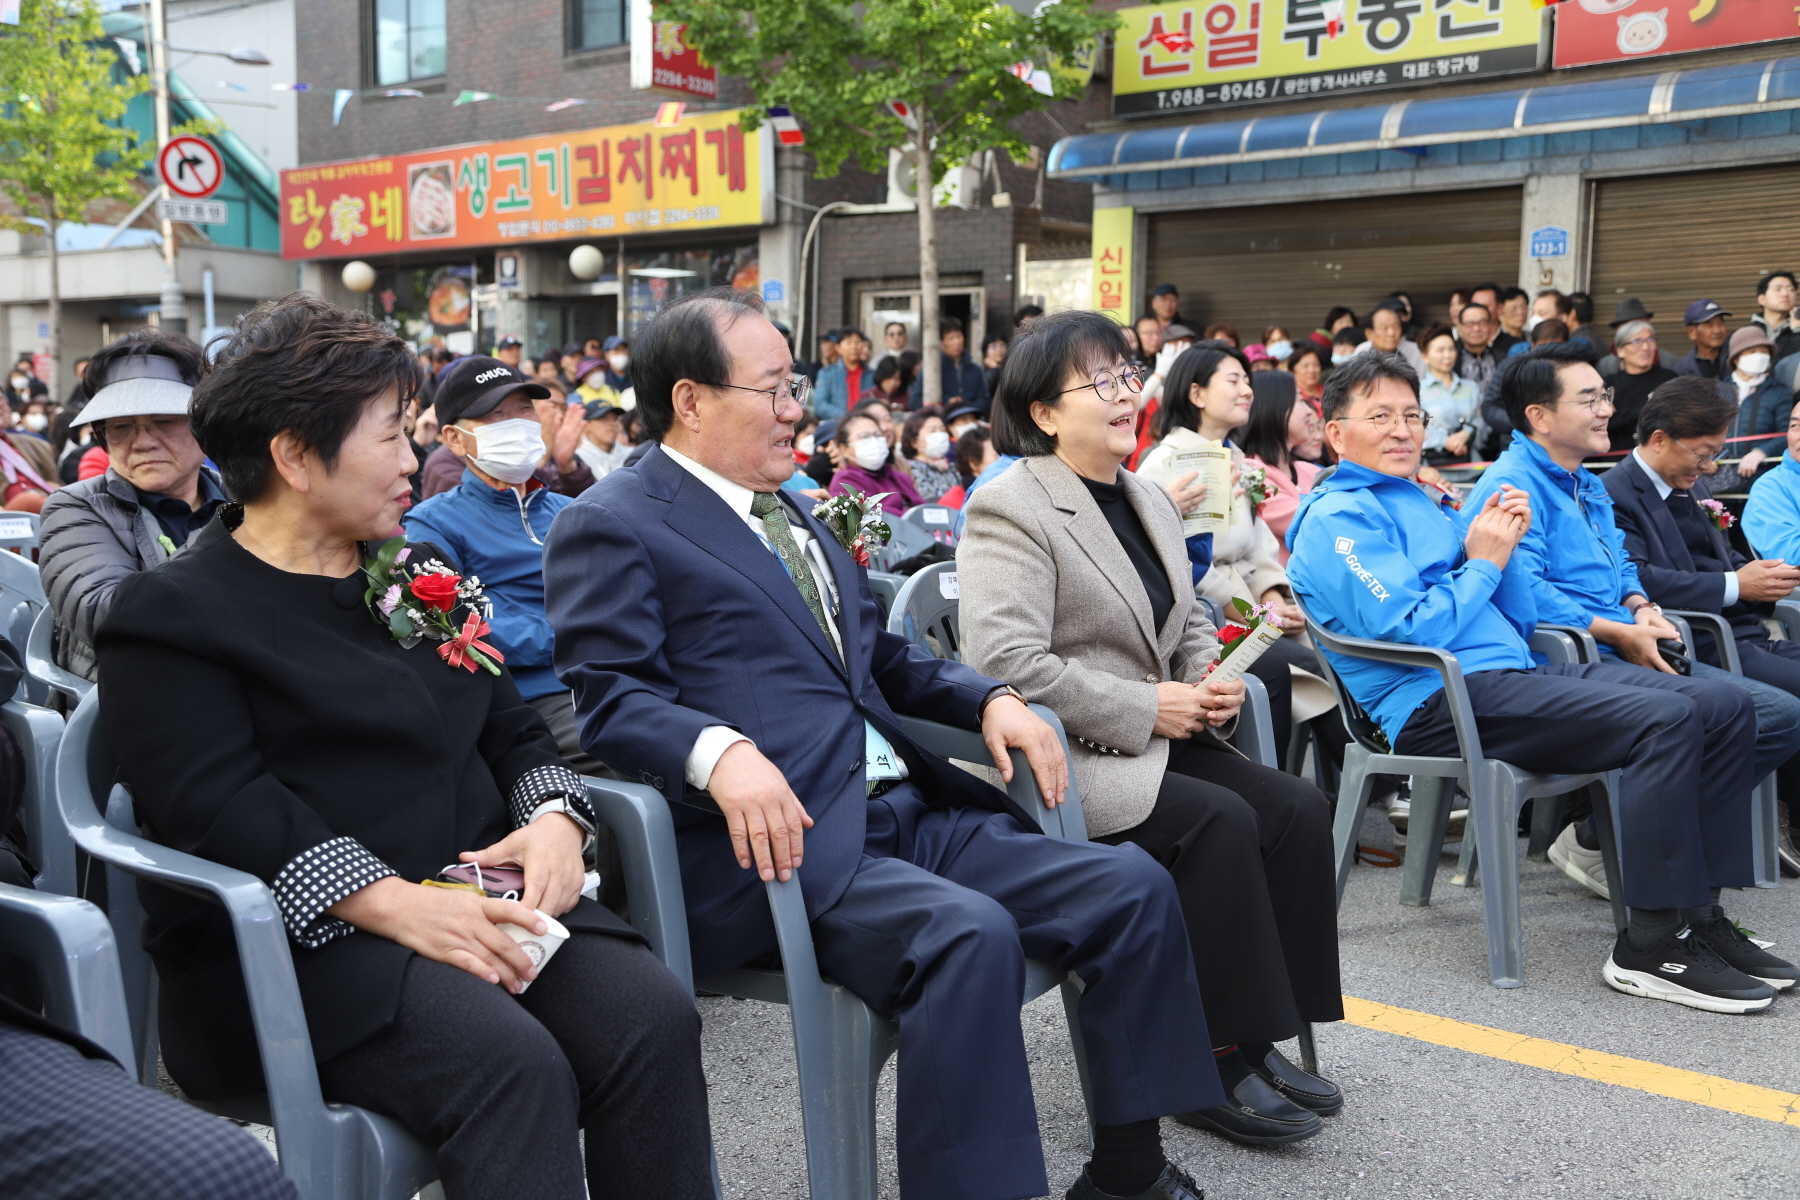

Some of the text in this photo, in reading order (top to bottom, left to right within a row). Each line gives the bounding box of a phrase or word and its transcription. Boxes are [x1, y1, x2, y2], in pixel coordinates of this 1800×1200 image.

[1138, 2, 1261, 78] 신일
[654, 67, 715, 95] 2294-3339
[1157, 79, 1267, 109] T.988-8945
[1283, 69, 1388, 96] 공인중개사사무소
[1534, 241, 1565, 255] 123-1
[1098, 246, 1124, 309] 신일
[1345, 554, 1391, 603] GORE-TEX
